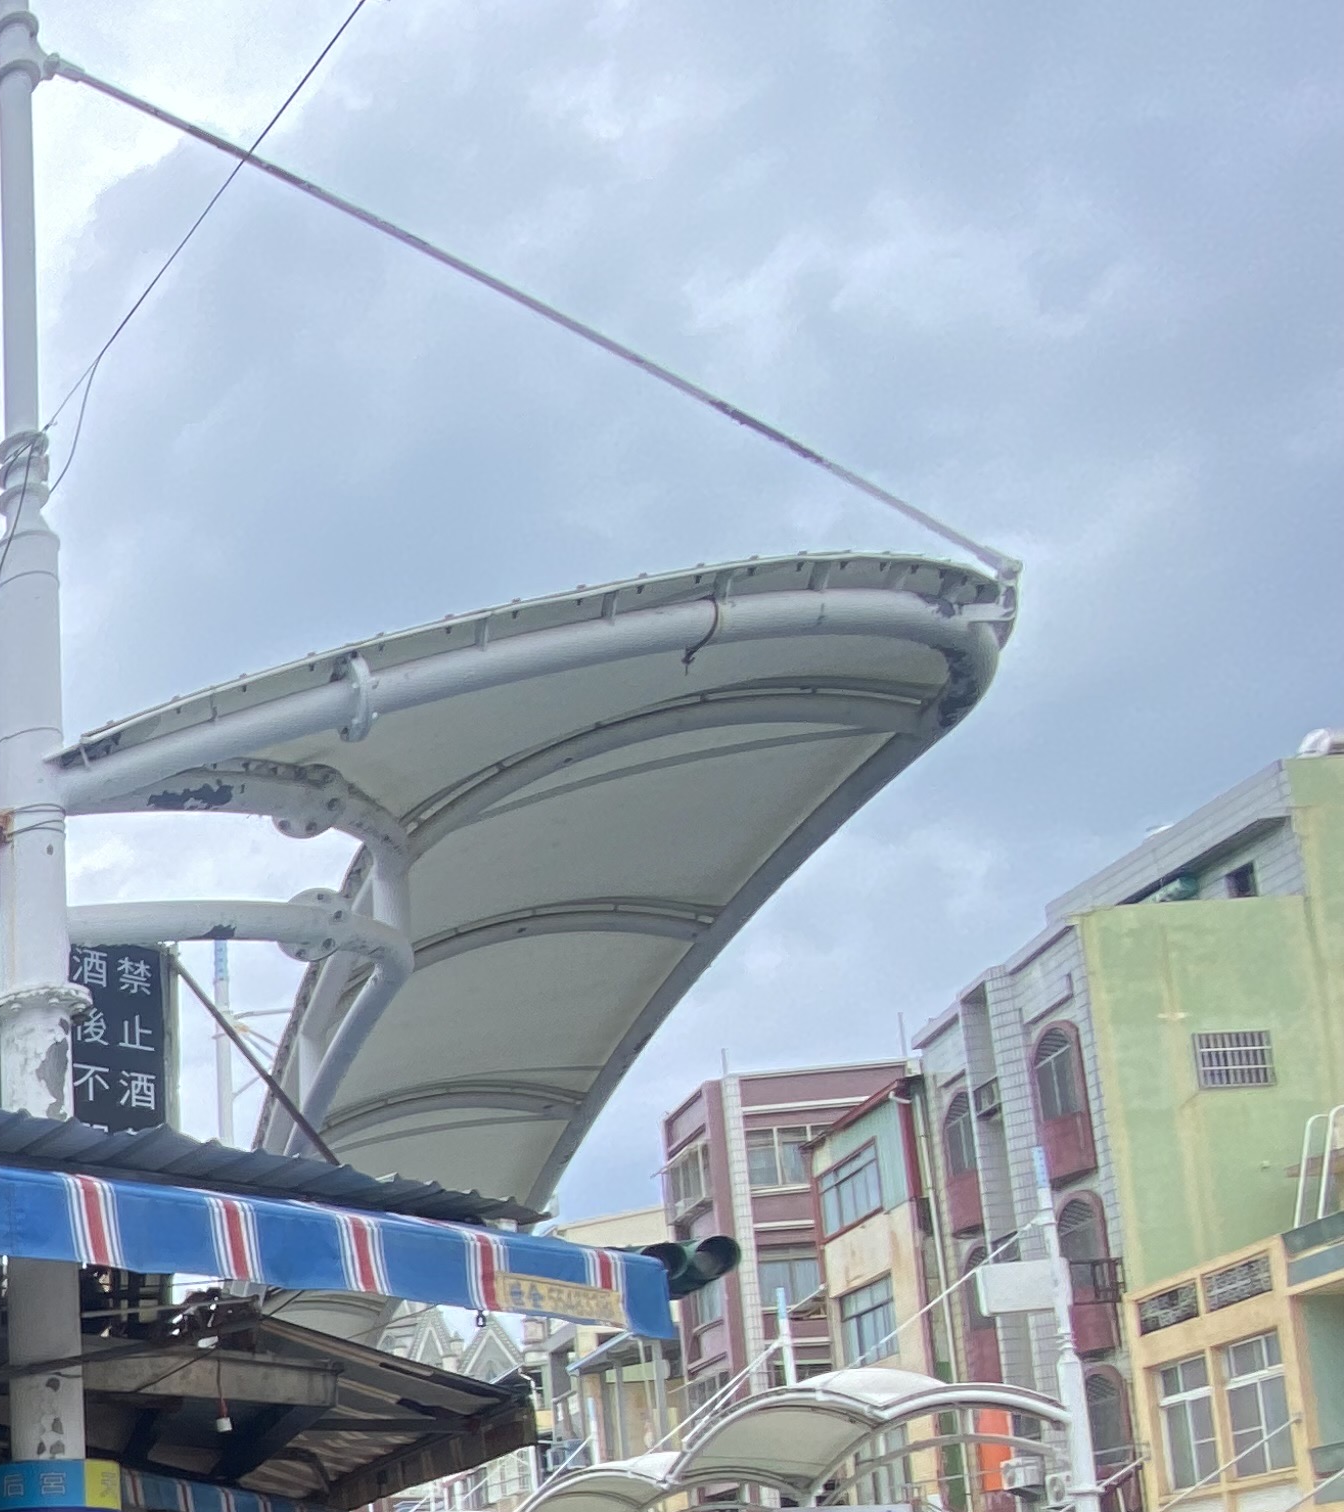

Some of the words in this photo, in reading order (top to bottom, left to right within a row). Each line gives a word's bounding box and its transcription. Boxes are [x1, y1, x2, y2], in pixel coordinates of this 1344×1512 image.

[73, 948, 109, 1132] 酒後不
[117, 957, 157, 1135] 禁止酒
[0, 1472, 67, 1498] 后宮
